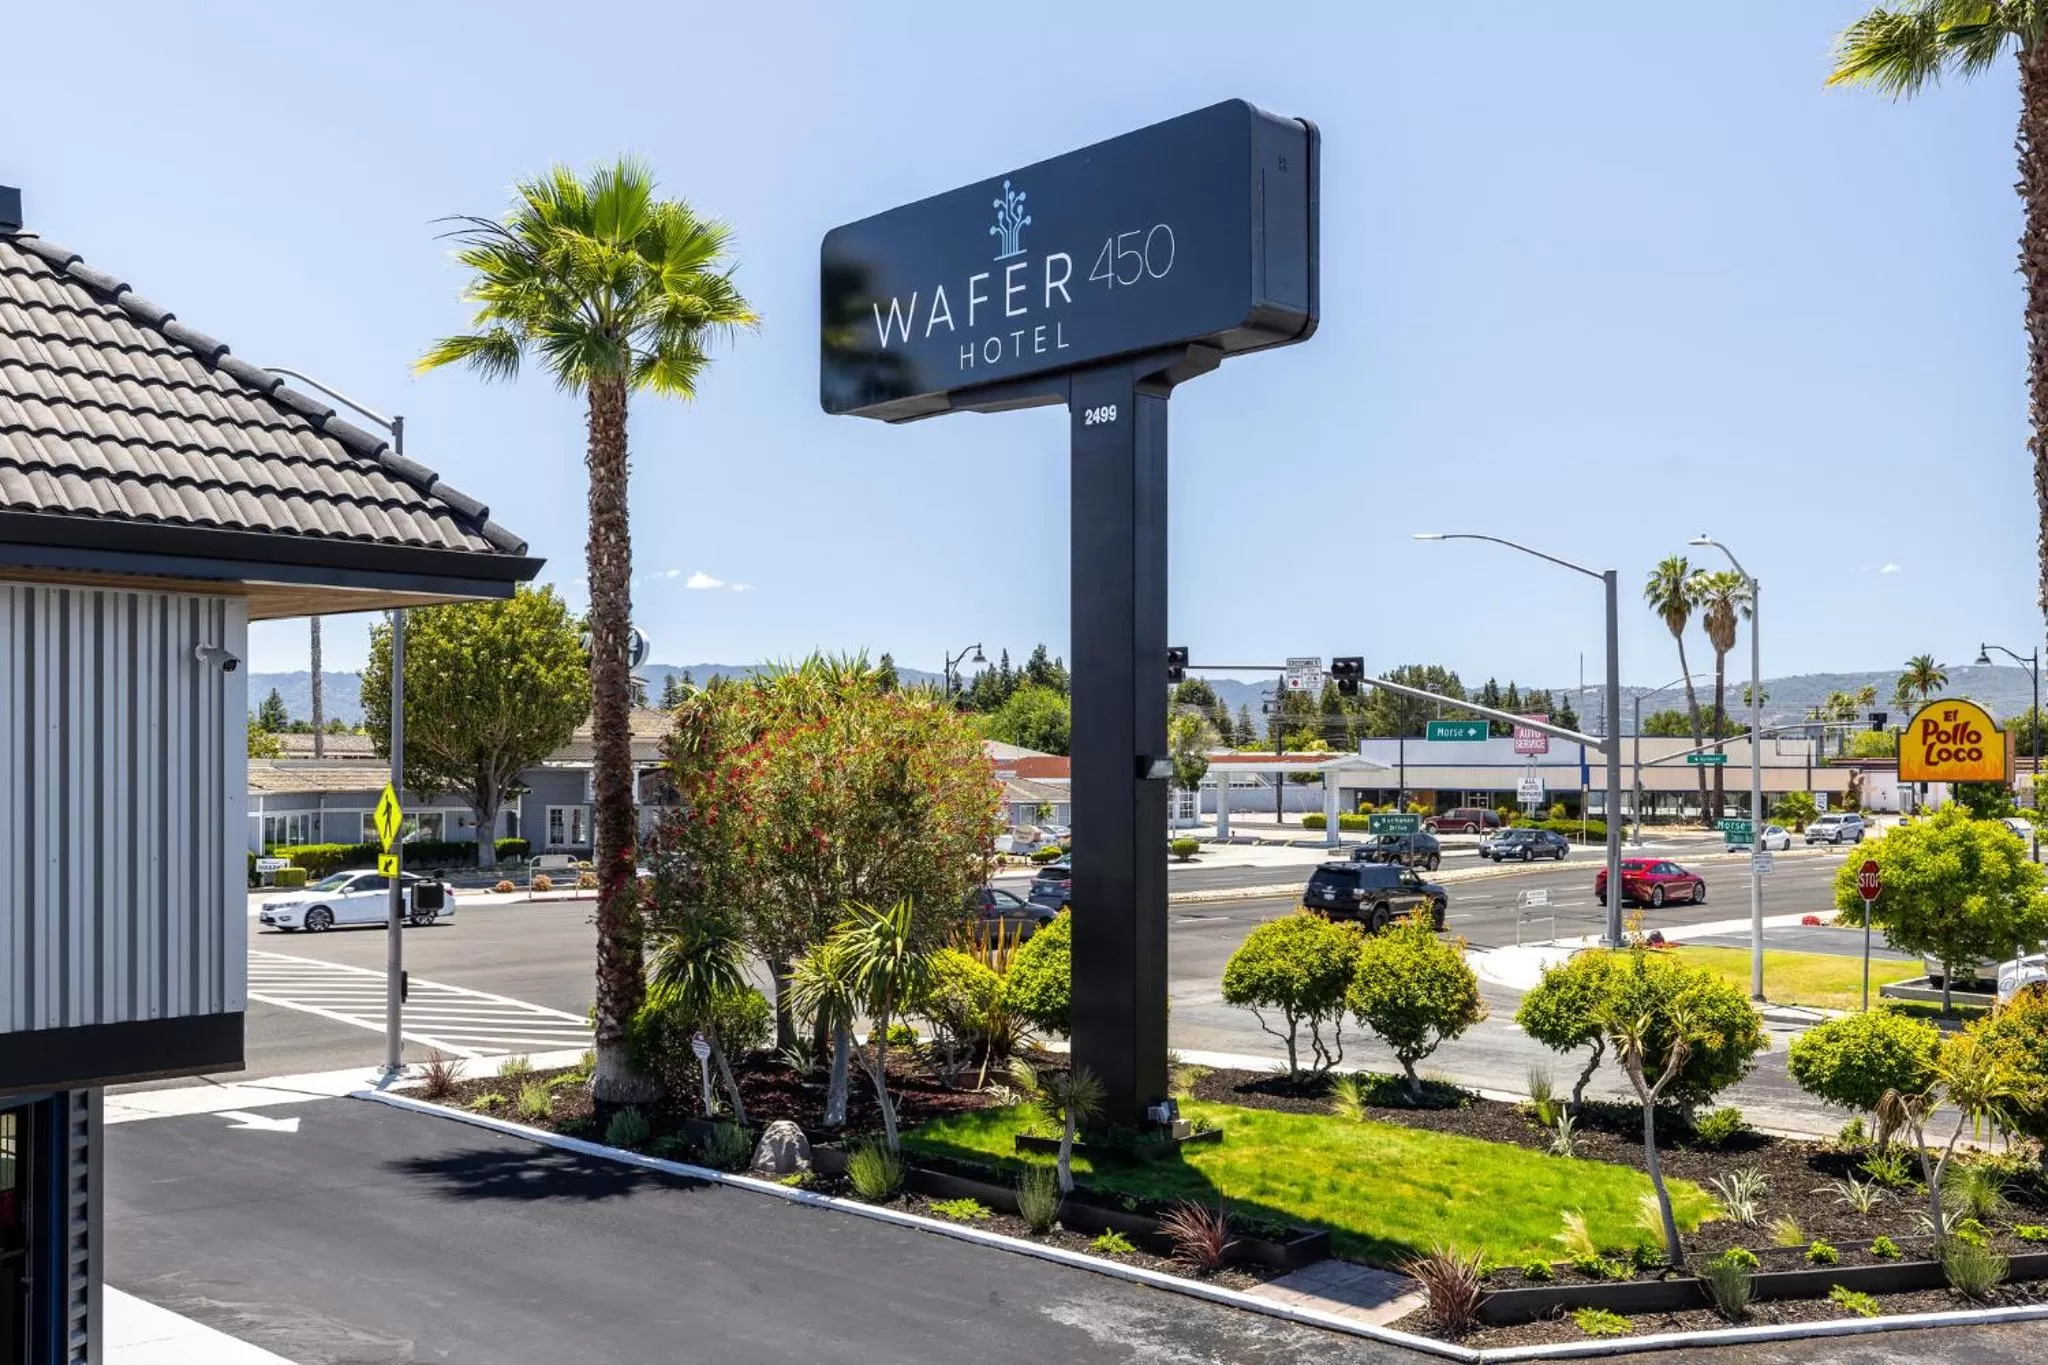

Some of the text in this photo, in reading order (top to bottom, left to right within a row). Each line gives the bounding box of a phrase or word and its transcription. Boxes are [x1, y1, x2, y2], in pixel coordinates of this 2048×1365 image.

[873, 223, 1175, 349] WAFER 450
[960, 320, 1070, 371] HOTEL
[1084, 404, 1117, 425] 2499
[1943, 709, 1959, 722] El
[1436, 727, 1464, 737] Morse
[1519, 727, 1541, 738] AUTO
[1921, 718, 1982, 747] Pollo
[1515, 739, 1546, 749] SERVICE
[1924, 741, 1983, 767] Loco
[1717, 820, 1747, 830] Morse
